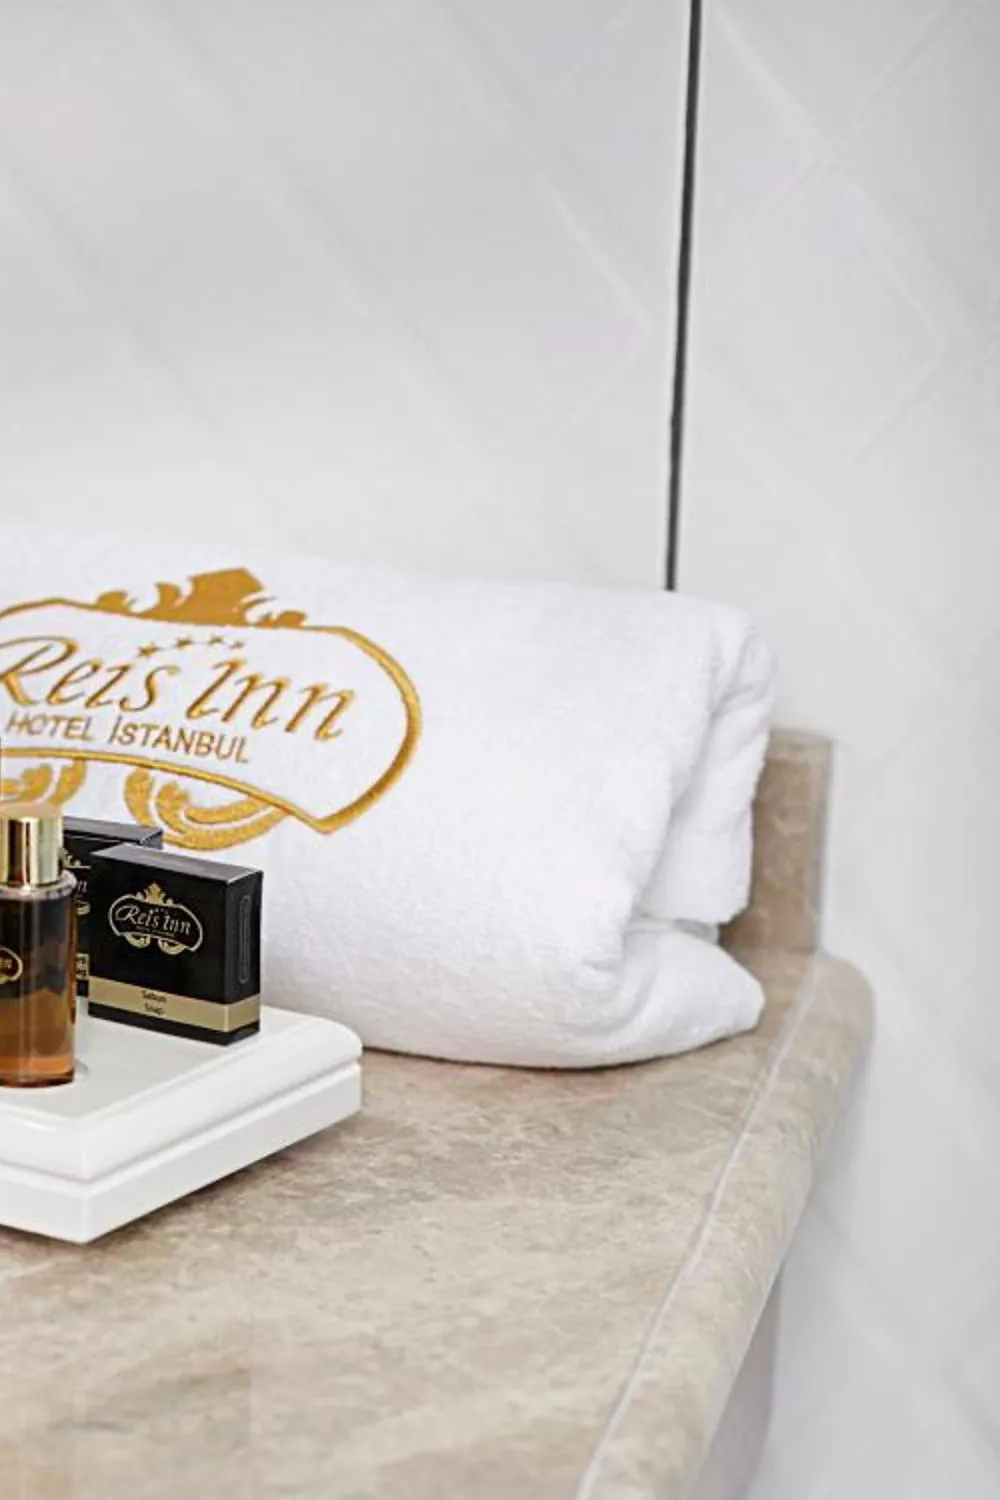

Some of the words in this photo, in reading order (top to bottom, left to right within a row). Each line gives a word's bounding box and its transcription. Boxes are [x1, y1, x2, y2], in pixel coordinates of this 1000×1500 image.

[185, 656, 358, 744] Inn
[4, 711, 96, 743] HOTEL
[115, 904, 160, 929] Reis
